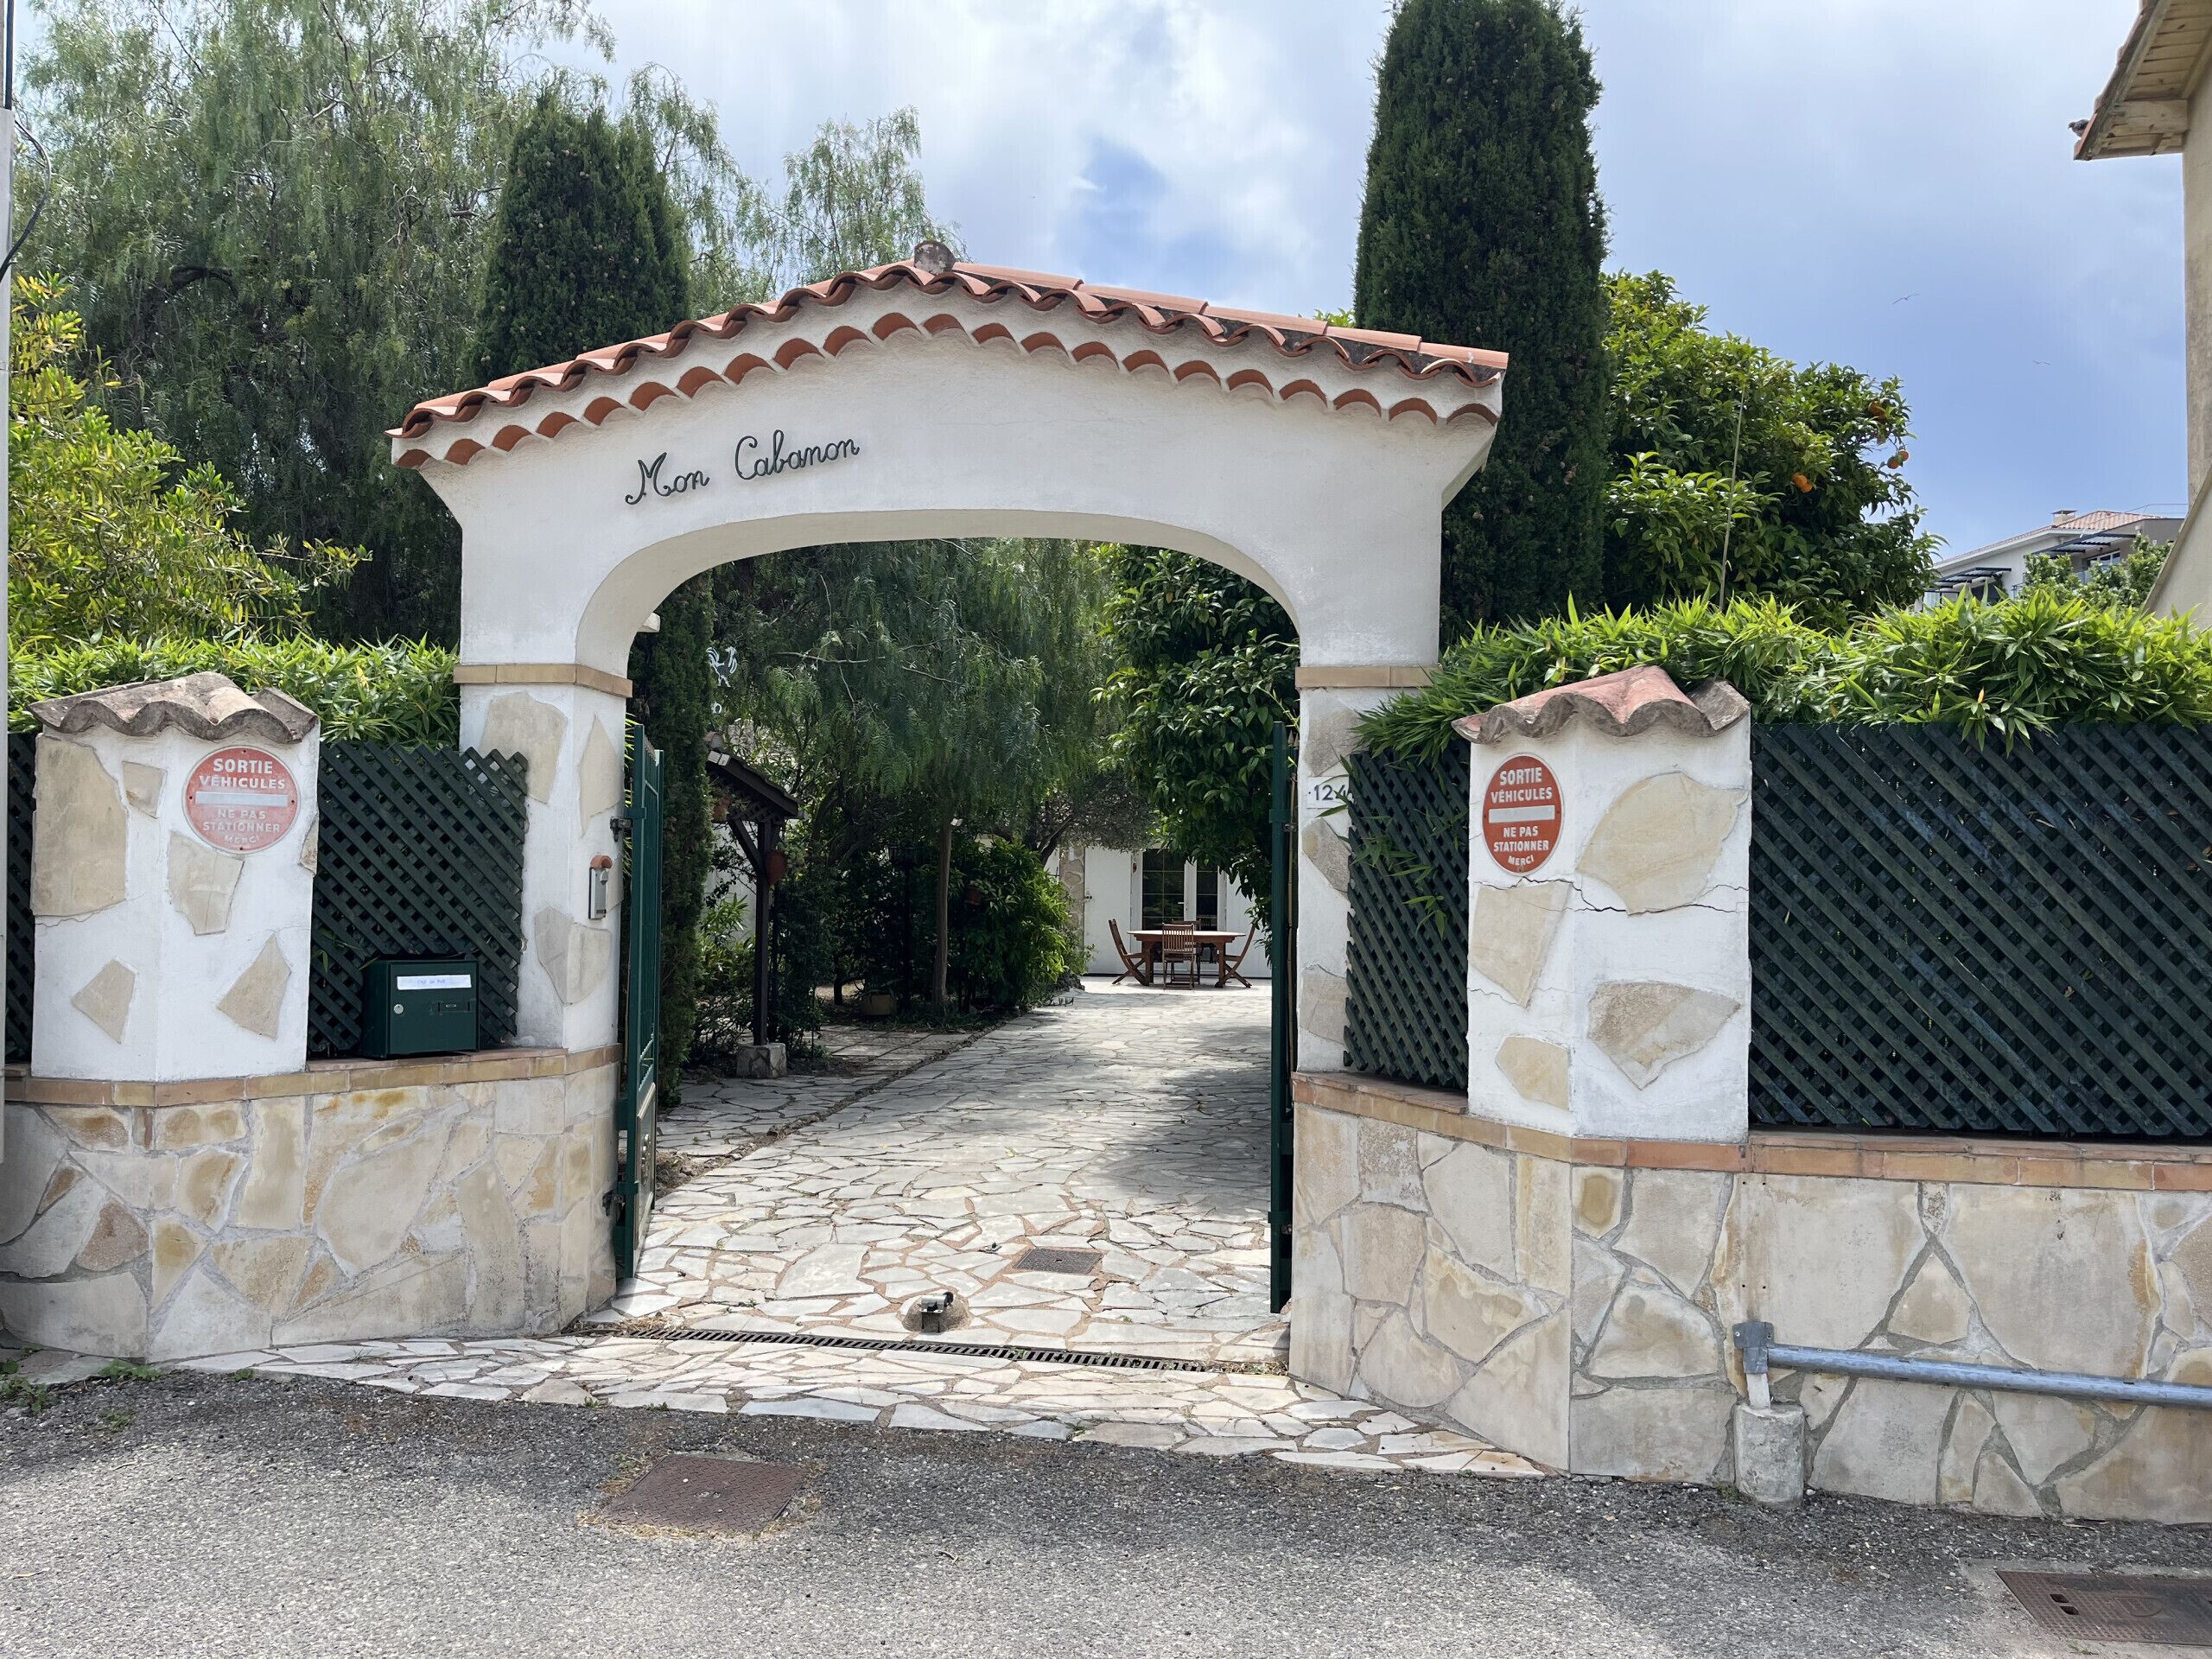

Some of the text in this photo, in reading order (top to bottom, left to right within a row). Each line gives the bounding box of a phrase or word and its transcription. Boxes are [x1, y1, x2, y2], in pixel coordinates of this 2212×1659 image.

[625, 429, 860, 505] Mon Cabanon
[213, 758, 273, 774] SORTIE
[199, 775, 286, 789] VÉHICULES
[1499, 766, 1542, 786] SORTIE
[1491, 786, 1553, 804] VÉHICULES
[217, 809, 267, 820] NE PAS
[202, 822, 281, 833] STATIONNER
[1503, 826, 1539, 838] NE PAS
[224, 834, 260, 844] MERCI
[1493, 840, 1549, 853] STATIONNER
[1508, 855, 1535, 866] MERCI
